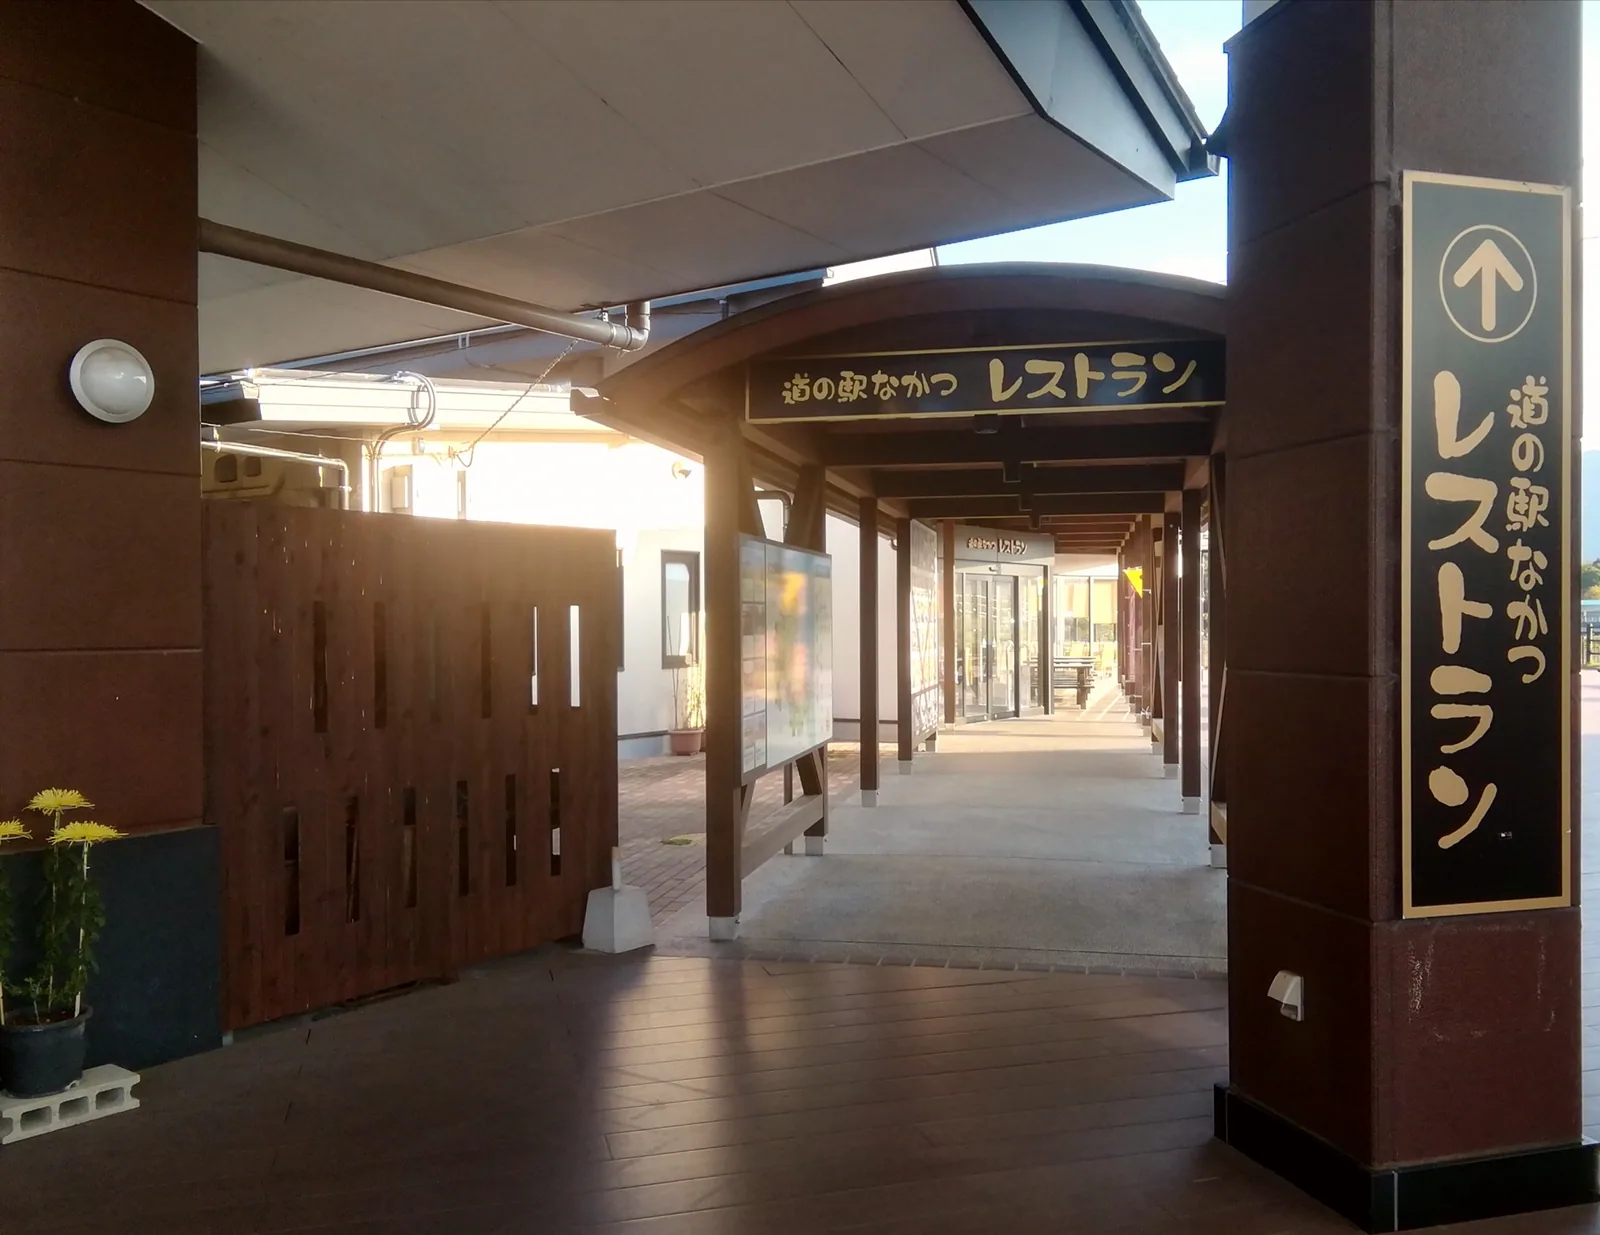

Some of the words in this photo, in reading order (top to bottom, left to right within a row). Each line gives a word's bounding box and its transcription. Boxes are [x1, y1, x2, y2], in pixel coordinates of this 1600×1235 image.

[781, 369, 958, 405] 道の駅なかつ
[988, 352, 1198, 403] レストラン
[1506, 375, 1550, 684] 道の駅なかつ
[1425, 369, 1500, 849] レストラン
